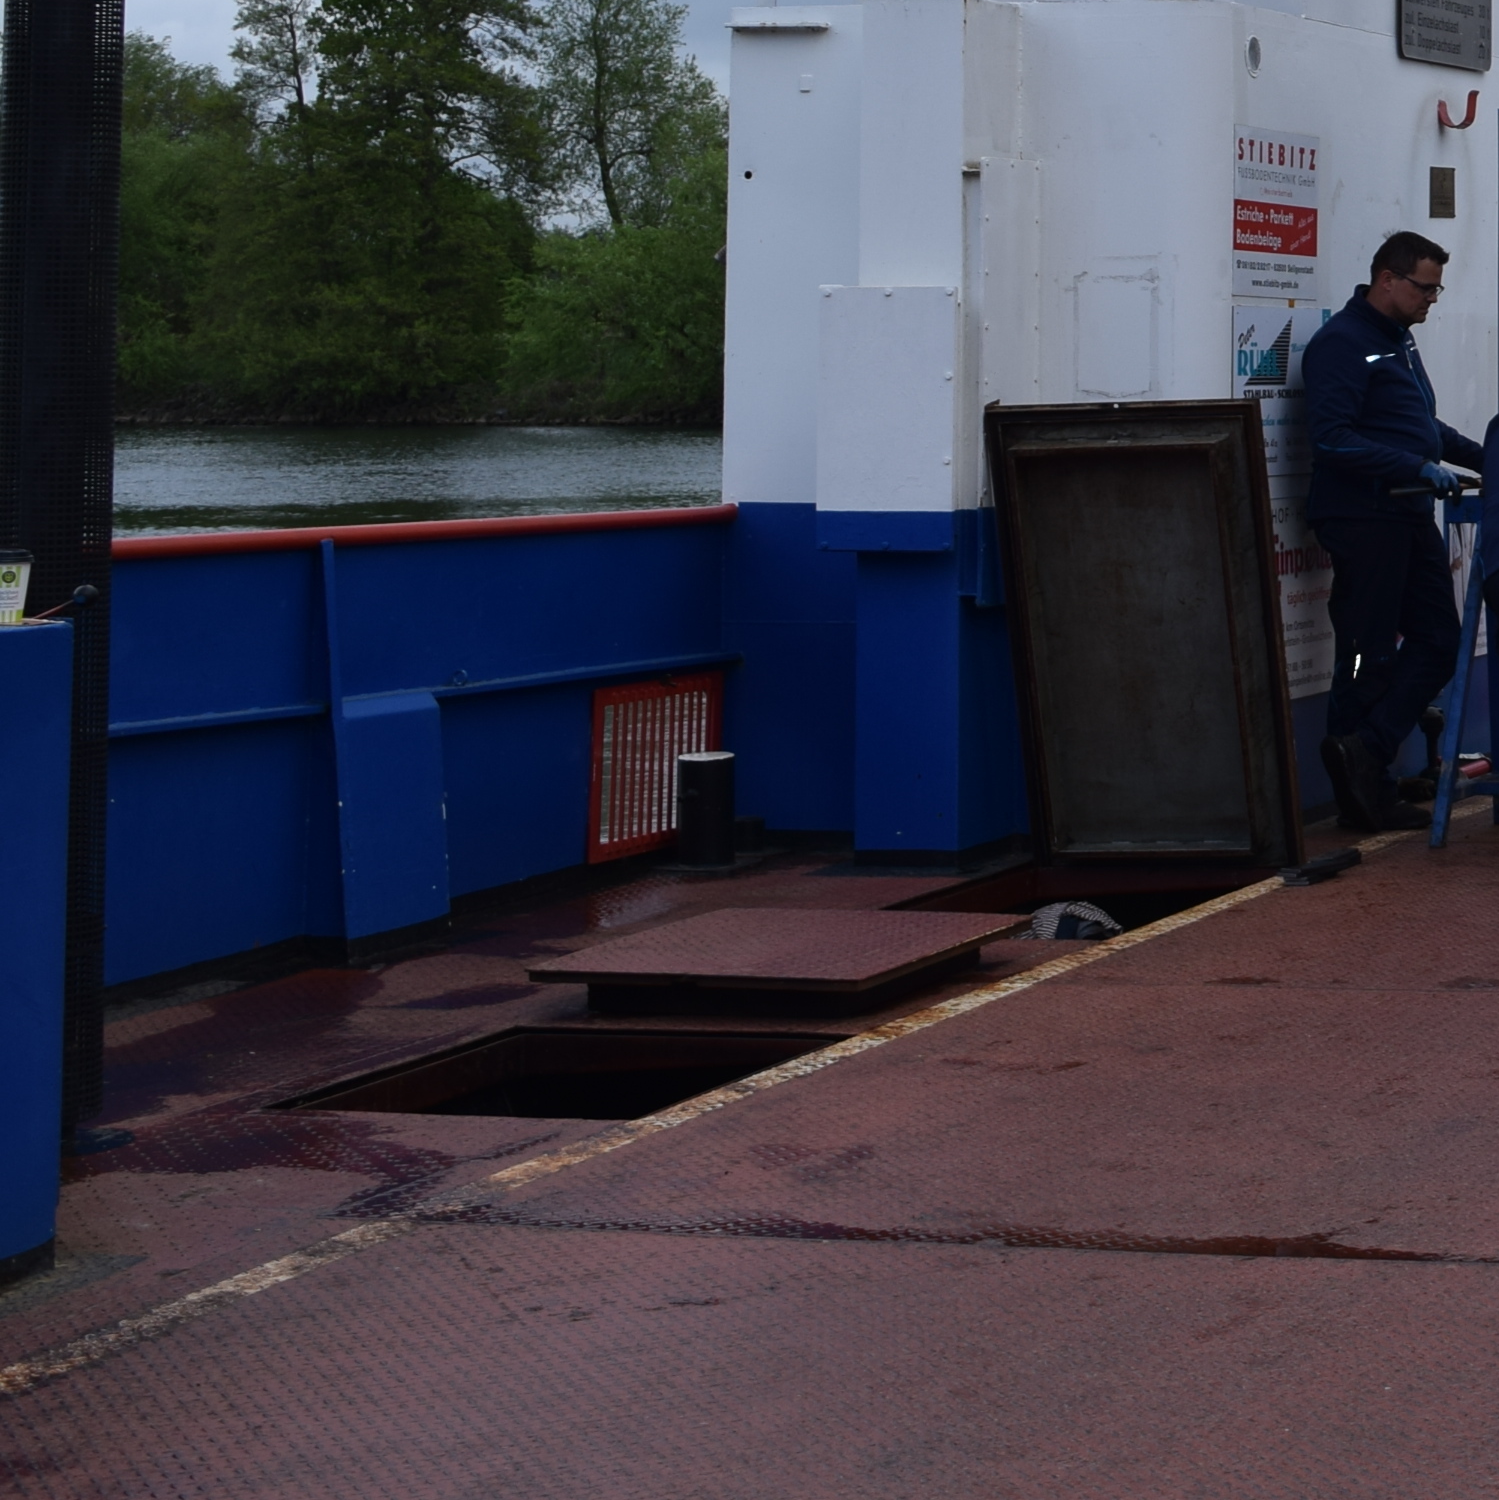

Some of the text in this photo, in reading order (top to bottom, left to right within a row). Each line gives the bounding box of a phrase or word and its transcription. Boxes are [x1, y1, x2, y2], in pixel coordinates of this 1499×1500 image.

[1237, 137, 1316, 171] STIEBITZ
[1236, 205, 1294, 226] Estriche Parkett
[1236, 228, 1283, 251] Bodenbeläge
